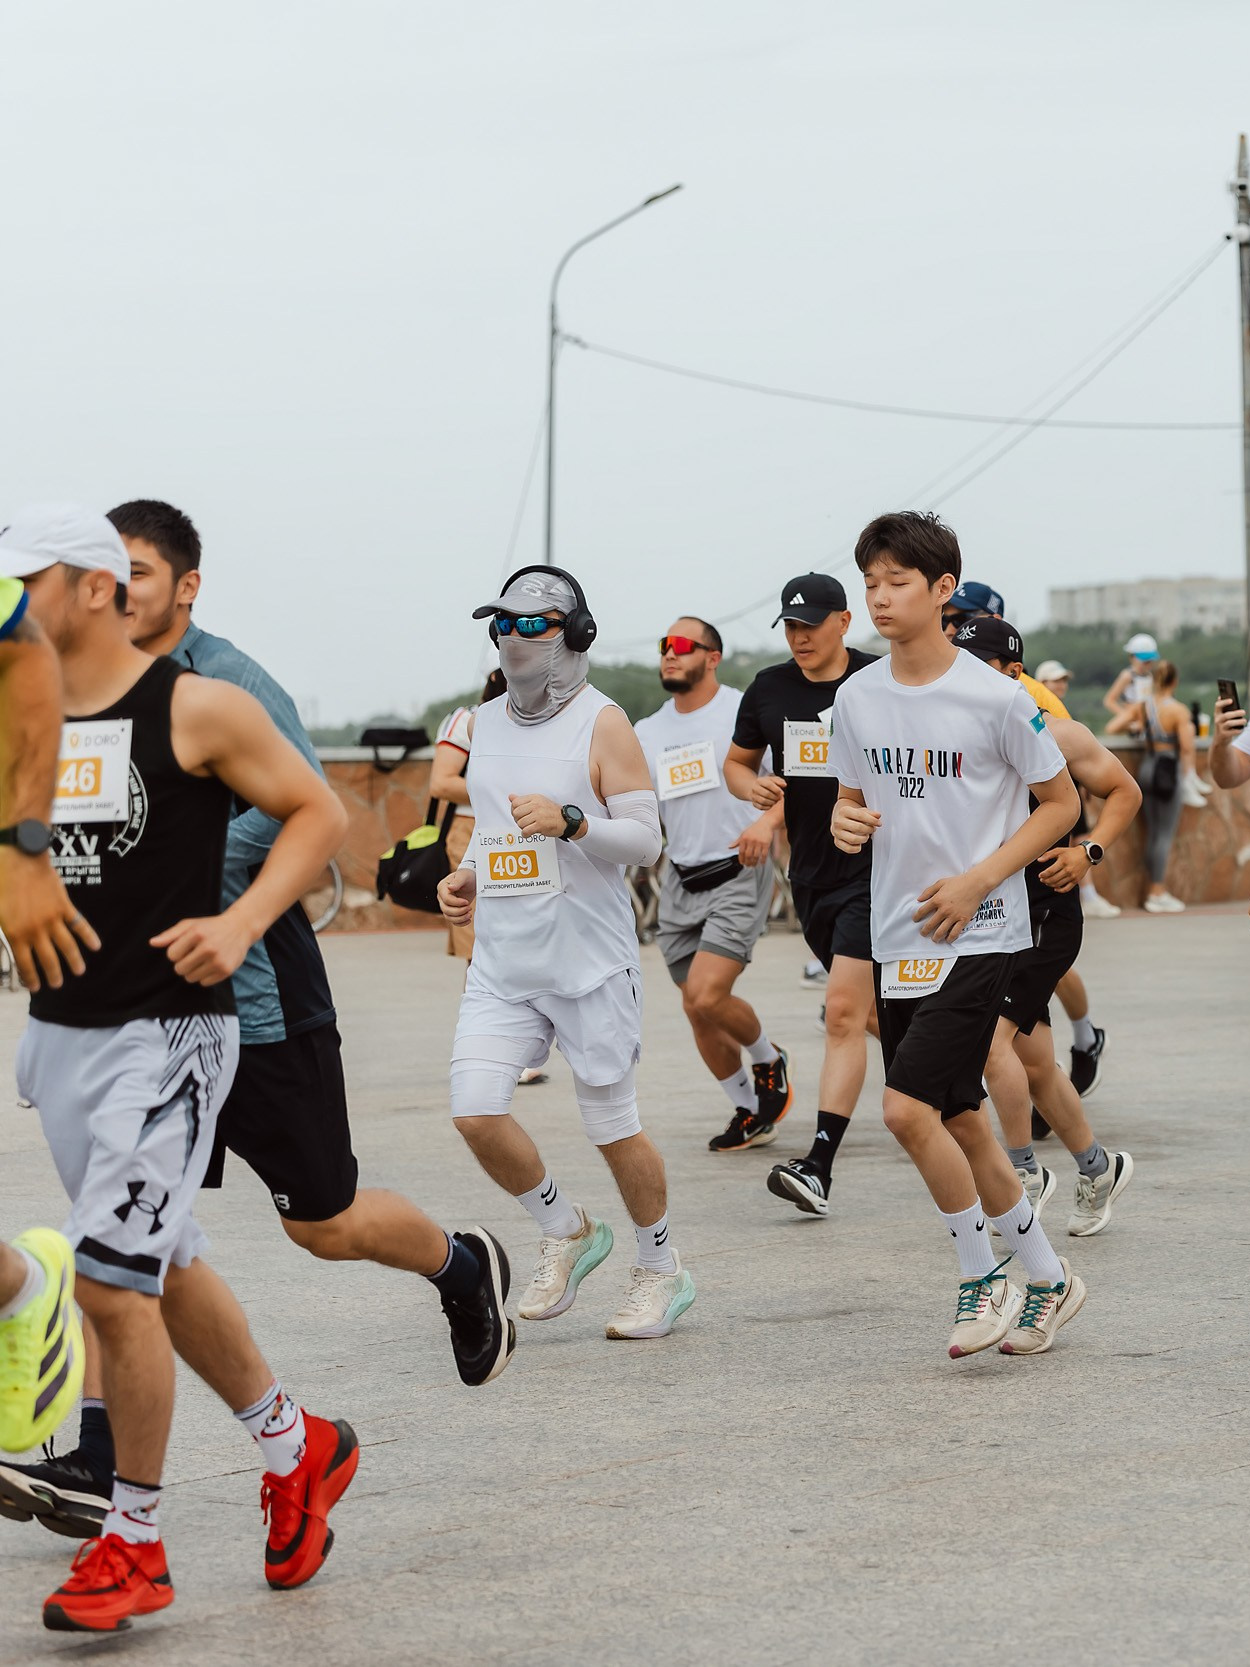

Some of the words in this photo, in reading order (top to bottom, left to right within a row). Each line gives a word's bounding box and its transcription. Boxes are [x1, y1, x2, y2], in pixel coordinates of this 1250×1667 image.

[1008, 636, 1019, 653] 01
[803, 743, 828, 761] 31
[672, 762, 701, 783] 339
[863, 747, 915, 775] TARAZ
[924, 749, 963, 778] RUN
[59, 761, 96, 794] 46
[897, 776, 925, 799] 2022
[49, 834, 99, 856] XV
[480, 837, 503, 846] LEONE
[517, 834, 547, 844] DORO
[493, 853, 532, 877] 409
[483, 880, 535, 890] БЛАГОТВОРИТЕЛЬНЫЙ
[535, 879, 552, 887] ЗАБЕГ
[903, 959, 939, 979] 482
[887, 984, 931, 992] БЛАГОТВОРИТЕЛЬНЫЙ
